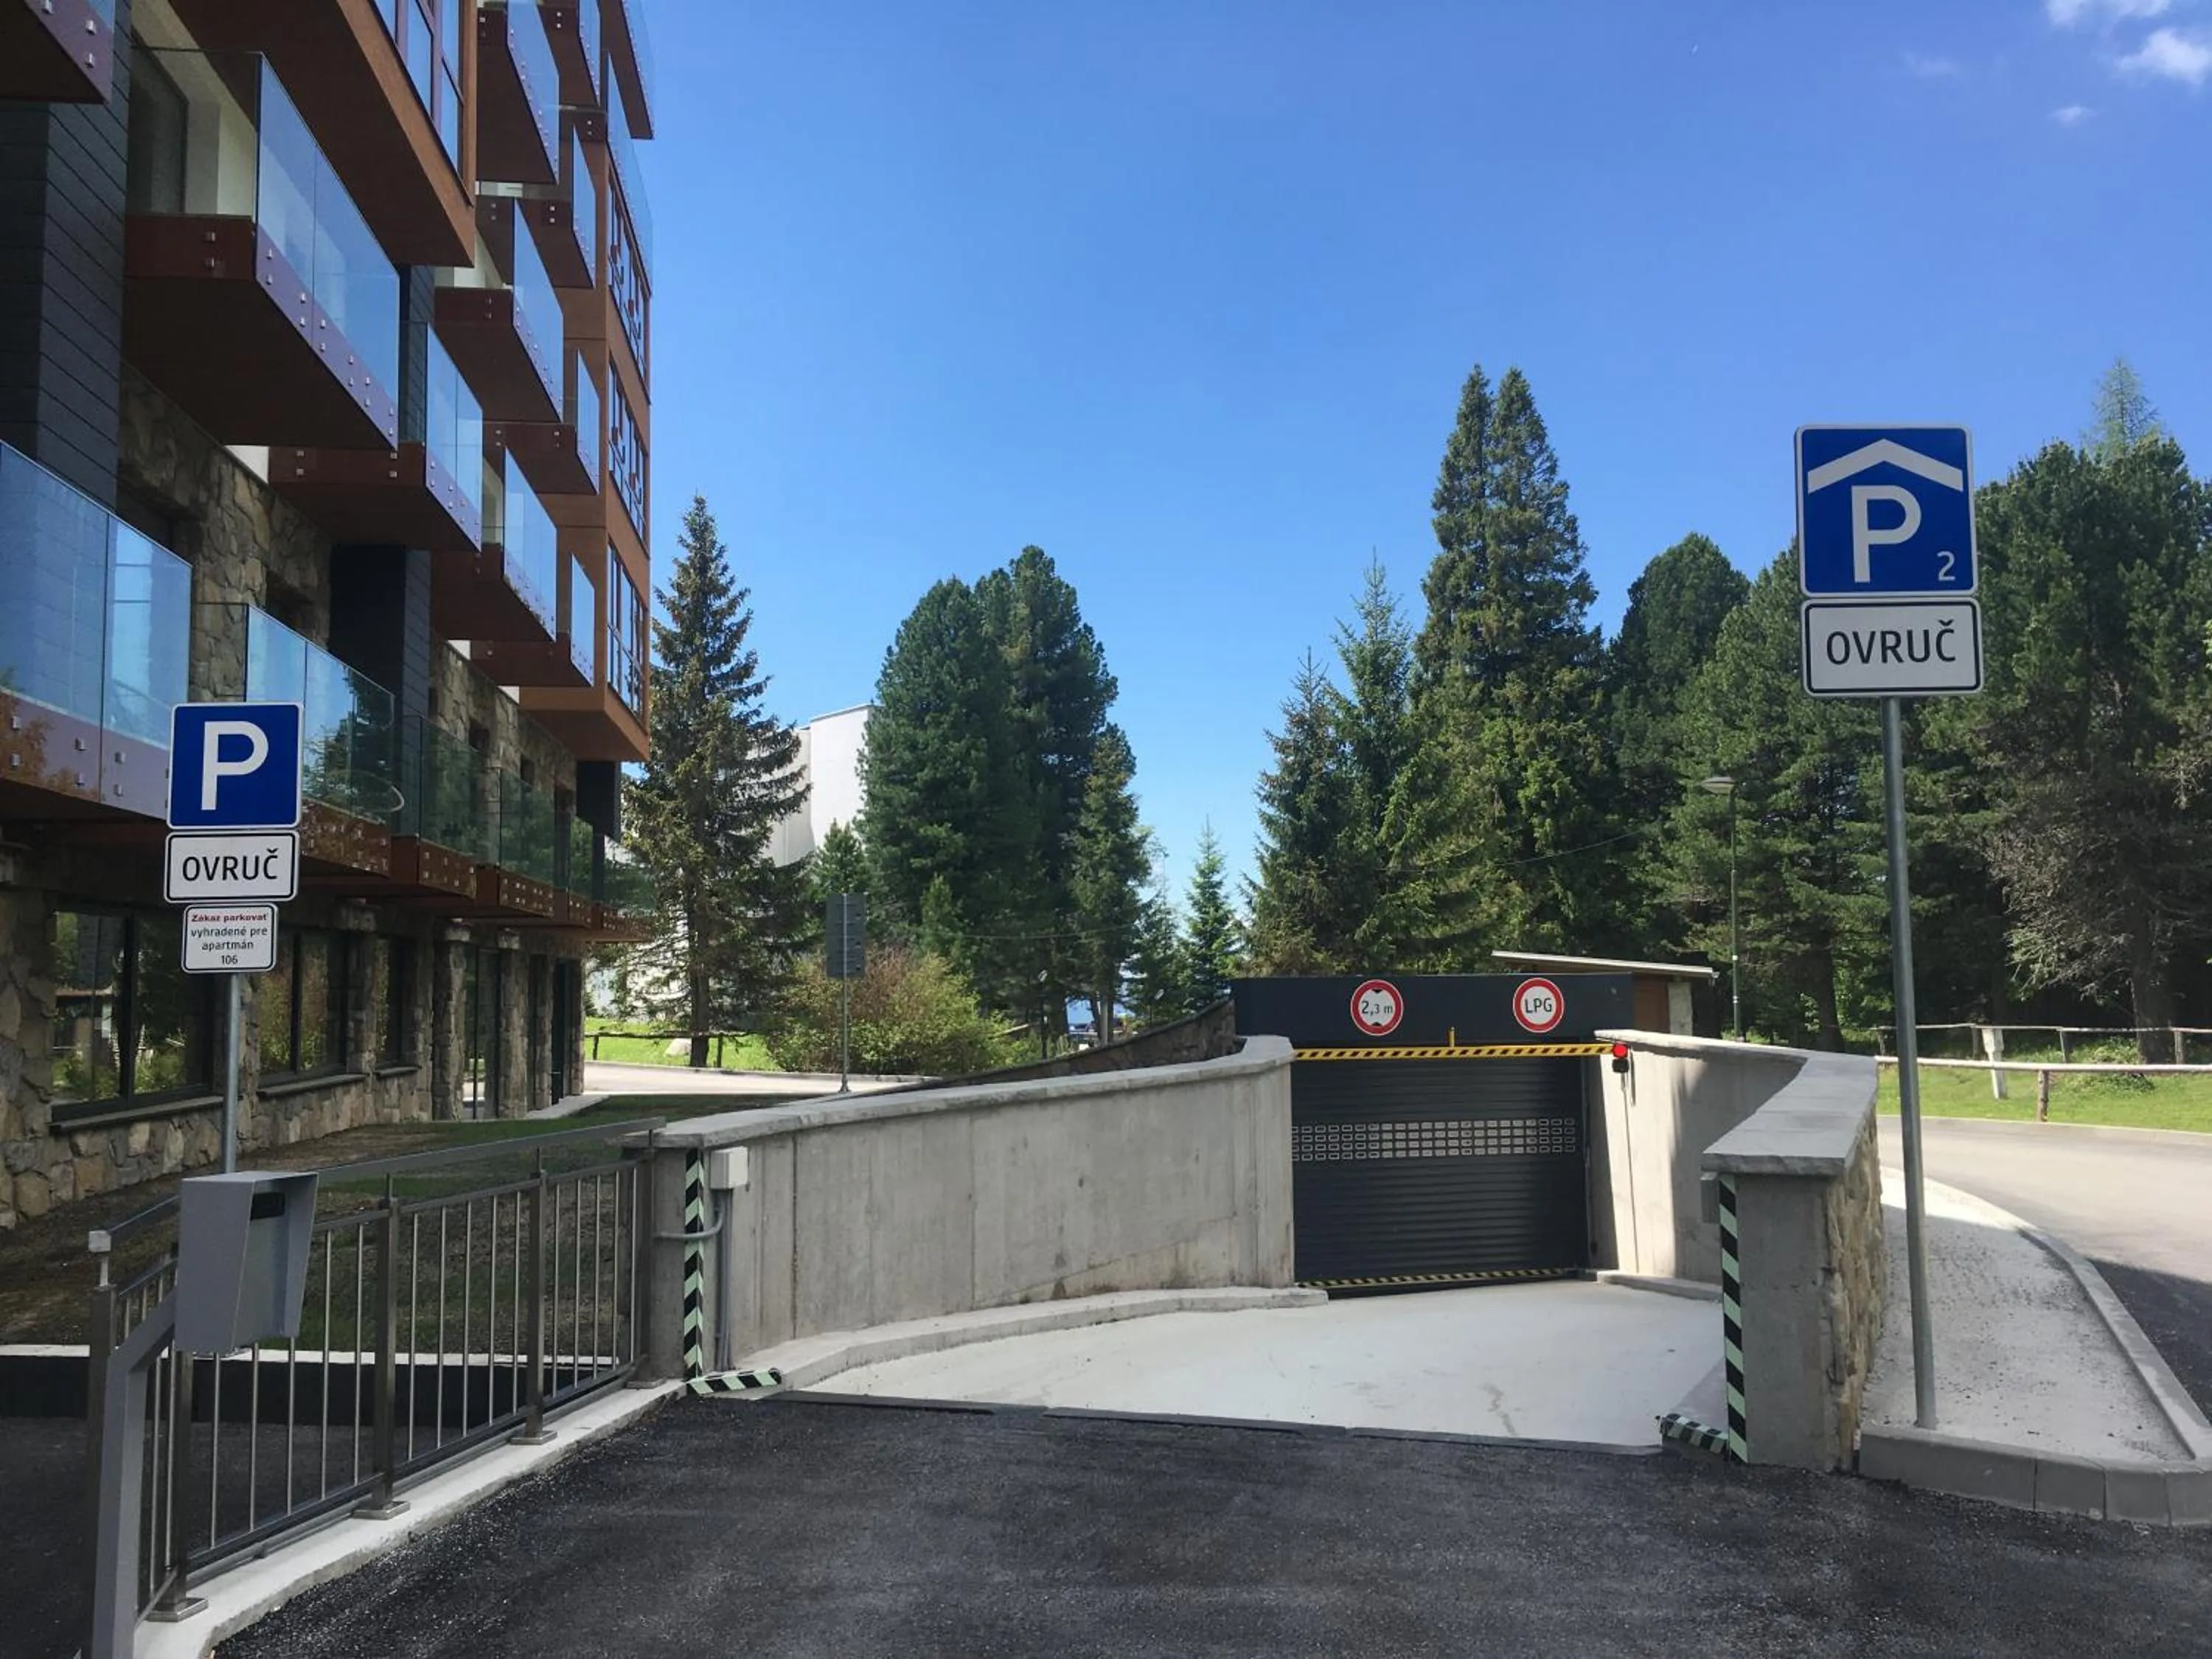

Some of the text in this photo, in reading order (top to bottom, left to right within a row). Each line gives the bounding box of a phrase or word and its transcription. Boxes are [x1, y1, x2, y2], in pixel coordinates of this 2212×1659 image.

[1851, 484, 1921, 583] P
[1937, 550, 1956, 581] 2
[1826, 619, 1956, 665] OVRUČ
[201, 720, 268, 811] P
[181, 848, 279, 882] OVRUČ
[191, 925, 268, 938] vyhradené pre
[201, 940, 254, 951] apartmán
[1361, 1000, 1394, 1016] 2,3 m
[1524, 997, 1553, 1014] LPG
